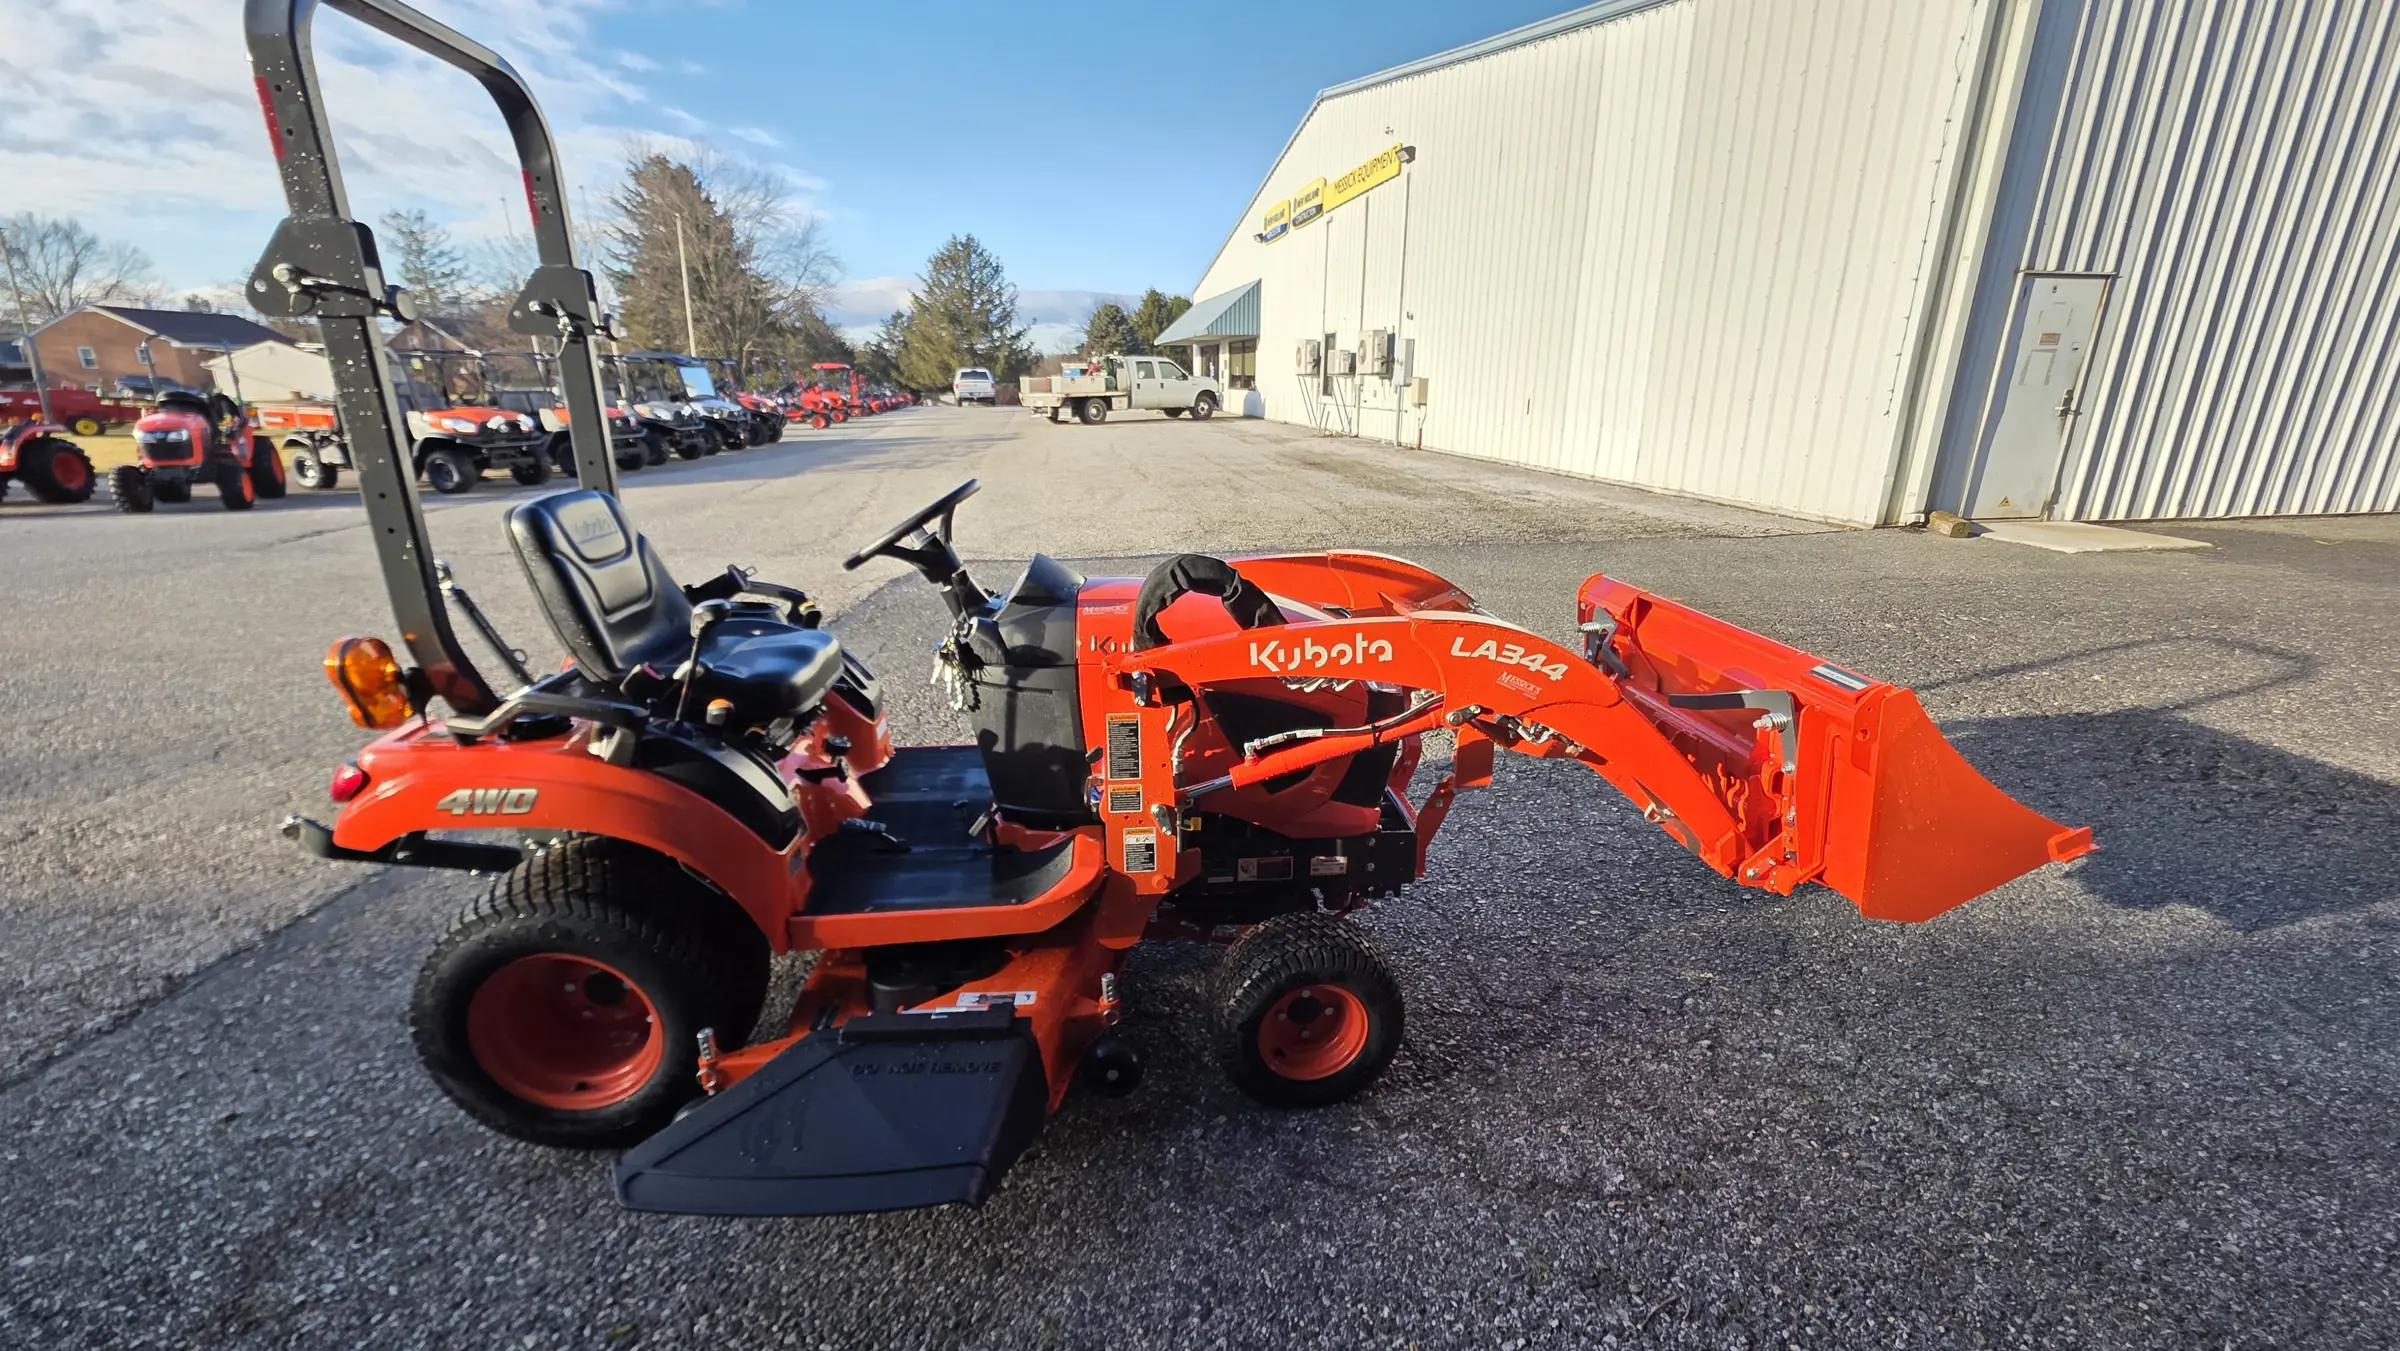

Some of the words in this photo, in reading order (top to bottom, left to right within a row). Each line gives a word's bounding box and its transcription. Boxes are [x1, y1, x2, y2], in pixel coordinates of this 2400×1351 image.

[1357, 145, 1398, 183] EQUIPMENT
[1249, 632, 1393, 672] Kubota
[1450, 637, 1569, 682] LA344
[436, 787, 539, 816] 4WD
[851, 1062, 879, 1076] DO
[887, 1062, 925, 1075] NOT
[929, 1060, 1003, 1075] REMOVE
